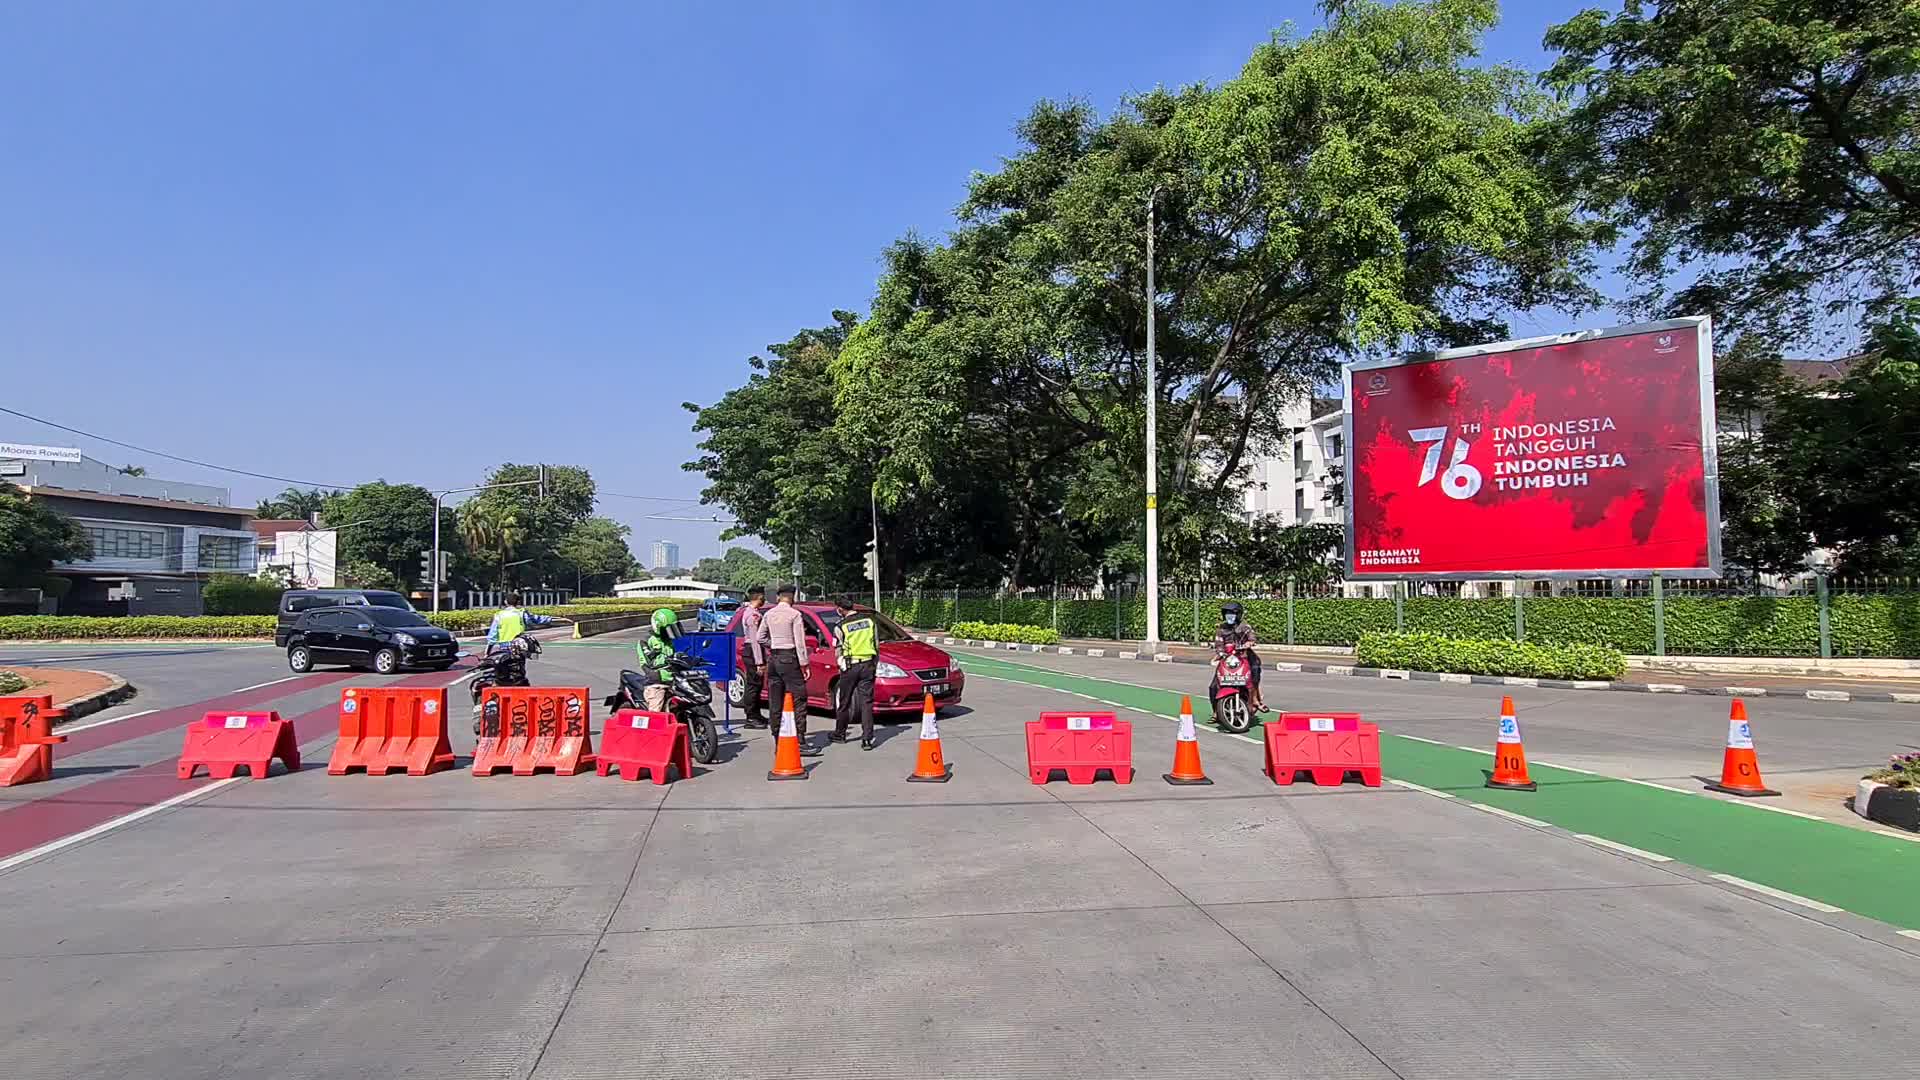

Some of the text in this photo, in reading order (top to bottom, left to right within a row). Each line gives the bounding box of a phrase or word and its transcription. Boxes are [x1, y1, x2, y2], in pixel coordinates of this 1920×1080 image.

[1492, 416, 1617, 441] INDONESIA
[0, 446, 80, 459] Moores Rowland
[1493, 436, 1597, 457] TANGGUH
[1407, 423, 1483, 500] 76 TH
[1493, 453, 1627, 475] INDONESIA
[1495, 472, 1589, 491] TUMBUH
[1360, 548, 1420, 558] DIRGAHAYU
[1360, 556, 1420, 566] INDONESIA
